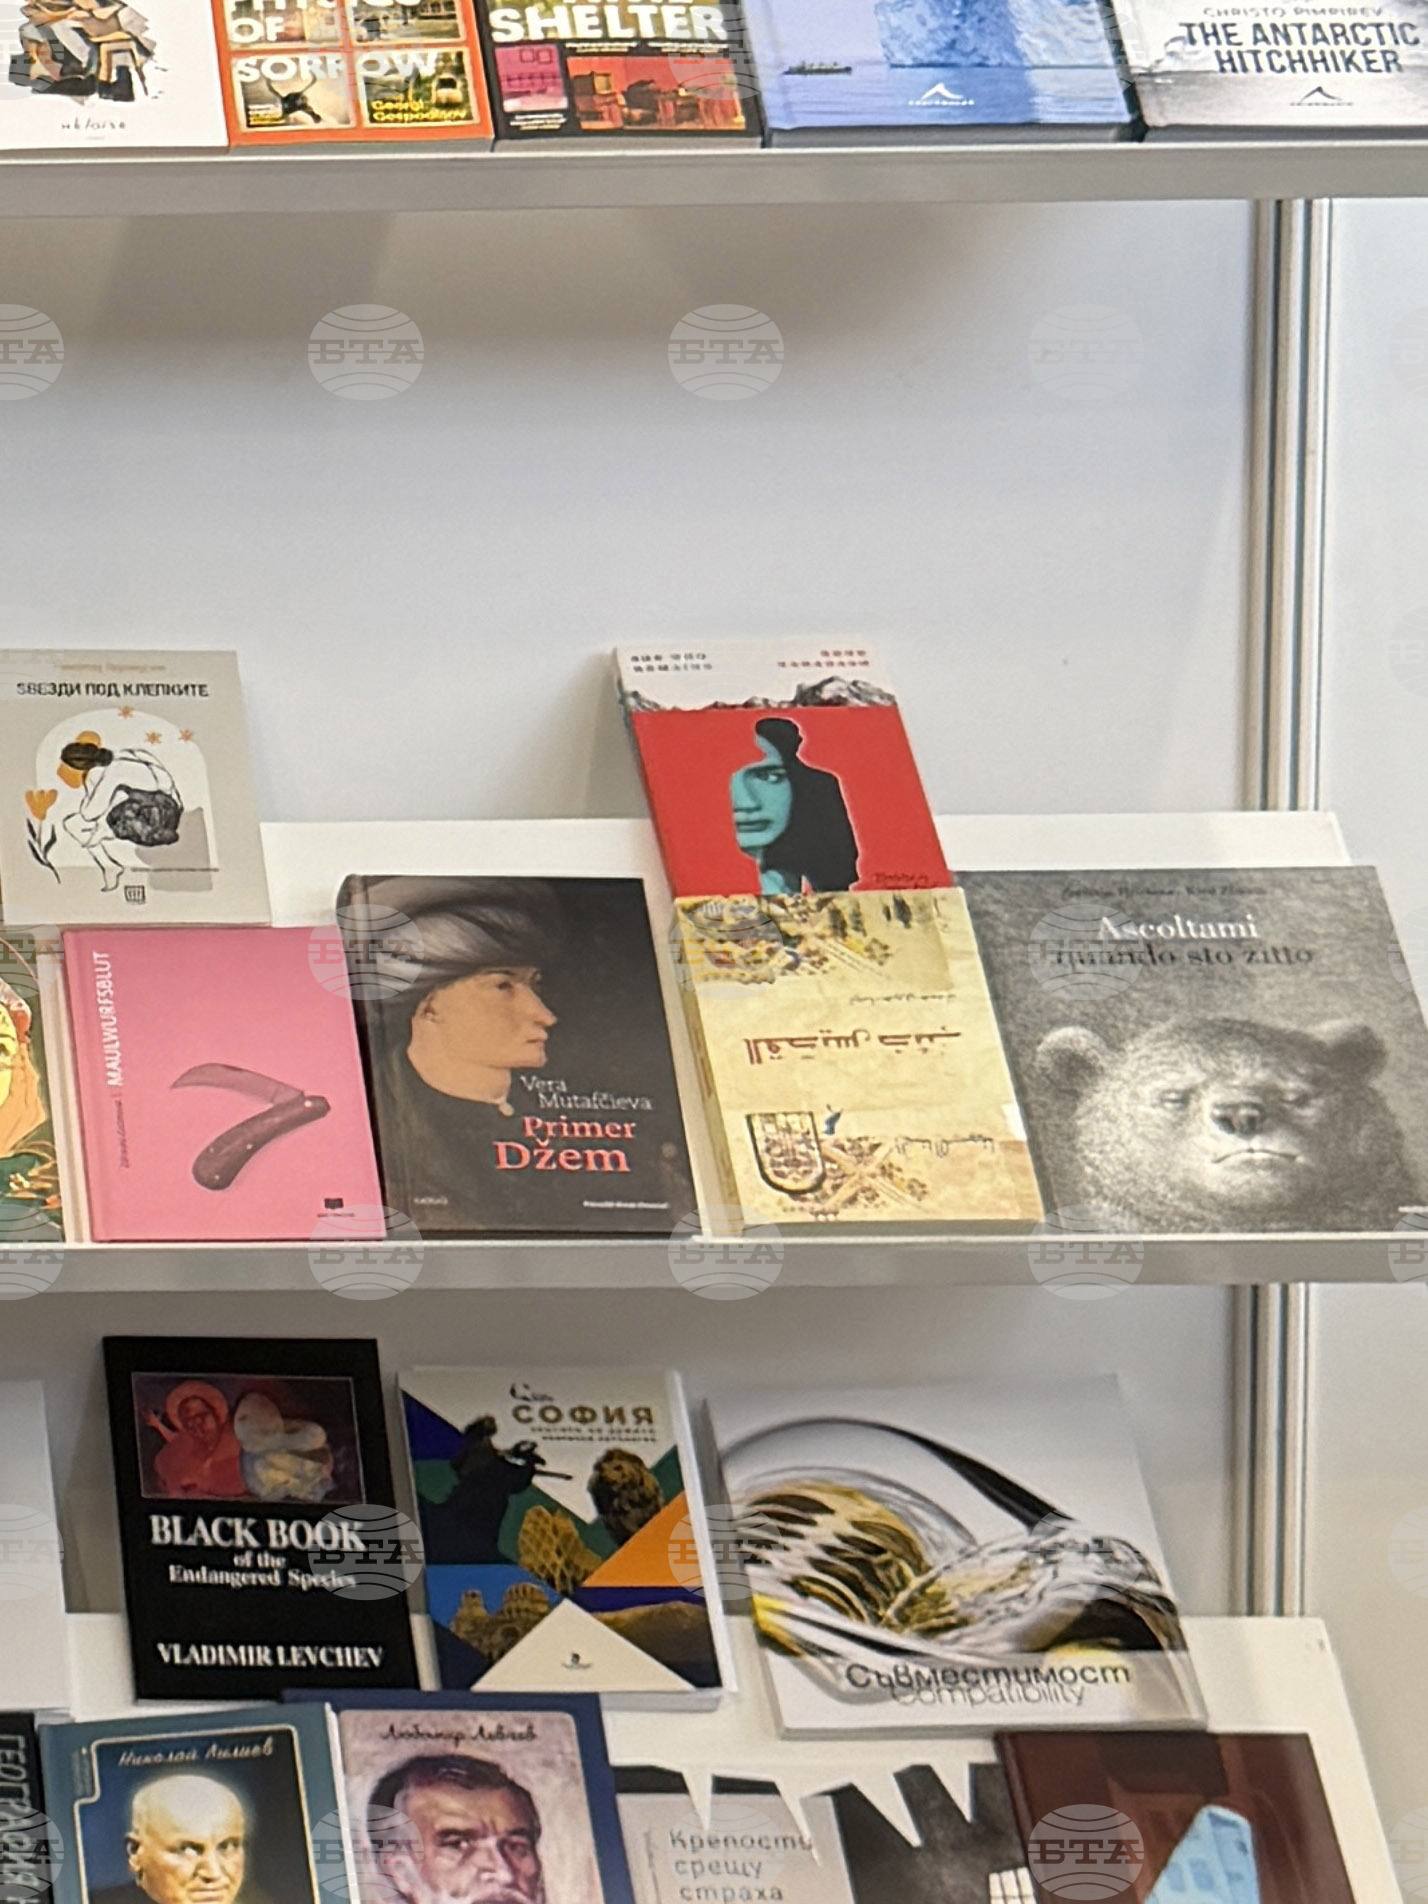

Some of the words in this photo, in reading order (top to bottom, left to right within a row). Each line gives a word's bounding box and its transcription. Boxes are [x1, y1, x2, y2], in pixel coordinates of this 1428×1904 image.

[230, 18, 286, 43] OF
[490, 6, 726, 43] SHELTER
[1179, 21, 1243, 47] THE
[1252, 21, 1420, 48] ANTARCTIC
[237, 53, 439, 83] SORROW
[1215, 49, 1404, 74] HITCHHIKER
[1098, 913, 1260, 940] Ascoltami
[521, 1115, 637, 1139] Primer
[493, 1137, 631, 1172] Džem
[512, 1404, 655, 1426] СОФИЯ
[149, 1514, 261, 1549] BLACK
[266, 1518, 368, 1552] BOOK
[156, 1643, 274, 1667] VLADIMIR
[276, 1645, 384, 1668] LEVCHEV
